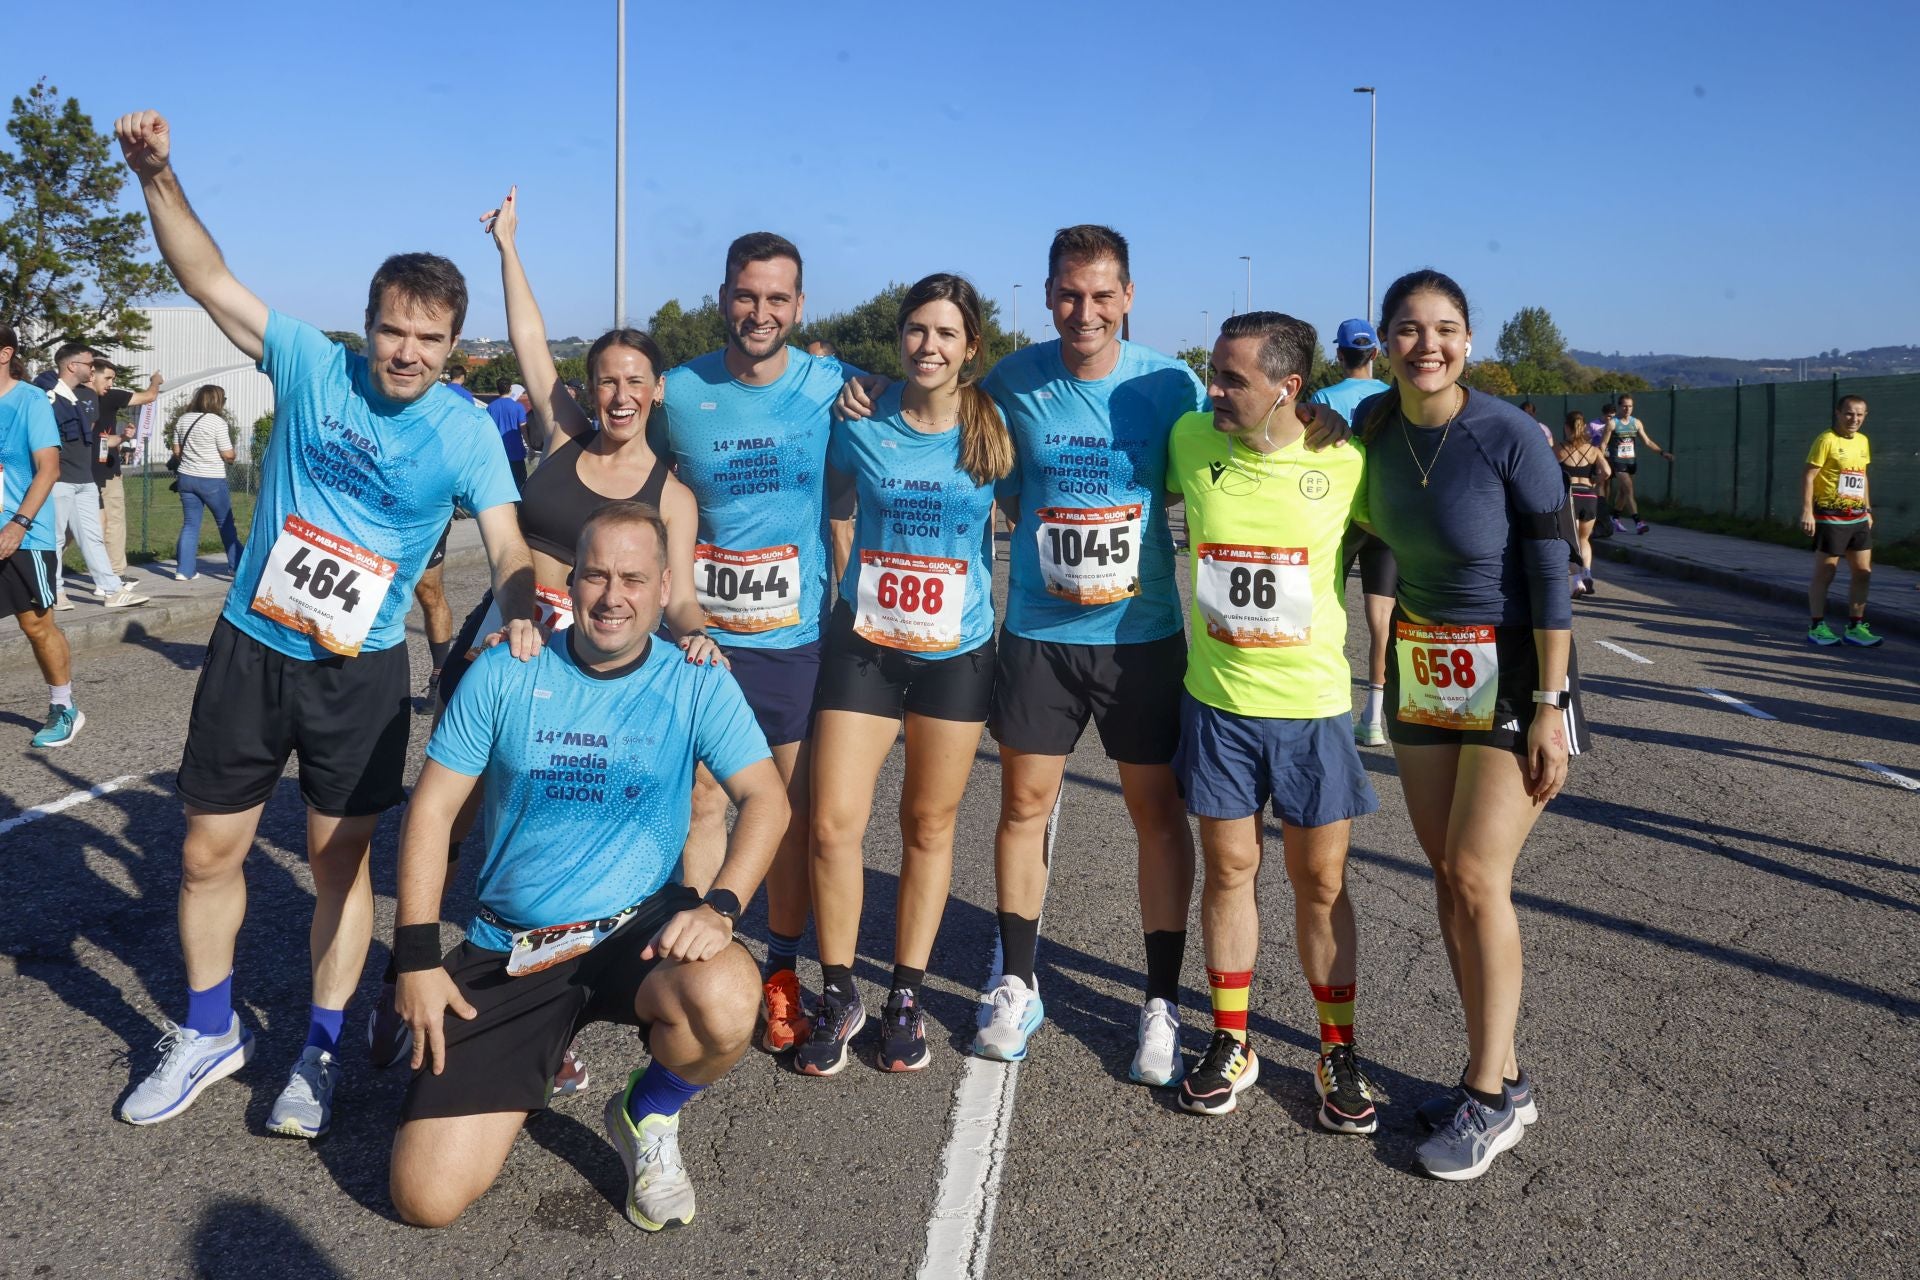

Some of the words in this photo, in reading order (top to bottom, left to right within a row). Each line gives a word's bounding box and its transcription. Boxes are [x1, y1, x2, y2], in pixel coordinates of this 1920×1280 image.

[321, 415, 344, 431] 14ª
[341, 428, 378, 458] MBA
[713, 440, 734, 452] 14ª
[736, 437, 776, 450] MBA
[1044, 434, 1067, 445] 14ª
[1069, 435, 1108, 448] MBA
[304, 444, 369, 484] maratón
[324, 441, 374, 472] media
[729, 453, 778, 468] media
[1060, 453, 1108, 467] media
[713, 465, 779, 482] maratón
[1043, 465, 1109, 480] maratón
[730, 480, 780, 496] GIJÓN
[880, 477, 902, 489] 14ª
[903, 479, 942, 493] MBA
[1058, 479, 1108, 495] GIJÓN
[893, 496, 942, 510] media
[879, 508, 941, 522] maratón
[892, 521, 940, 538] GIJÓN
[315, 535, 338, 550] MBA
[1048, 525, 1130, 567] 1045
[724, 554, 744, 562] MBA
[761, 550, 783, 560] GIJÓN
[892, 557, 911, 567] MBA
[1230, 550, 1252, 558] MBA
[284, 546, 361, 613] 464
[704, 563, 789, 601] 1044
[1229, 566, 1276, 610] 86
[877, 572, 944, 615] 688
[288, 595, 313, 611] ALFREDO
[313, 607, 334, 620] RAMOS
[1416, 630, 1434, 639] MBA
[1411, 646, 1476, 688] 658
[535, 729, 561, 743] 14ª
[562, 732, 608, 748] MBA
[550, 753, 607, 770] media
[530, 768, 606, 785] maratón
[545, 785, 604, 804] GIJÓN
